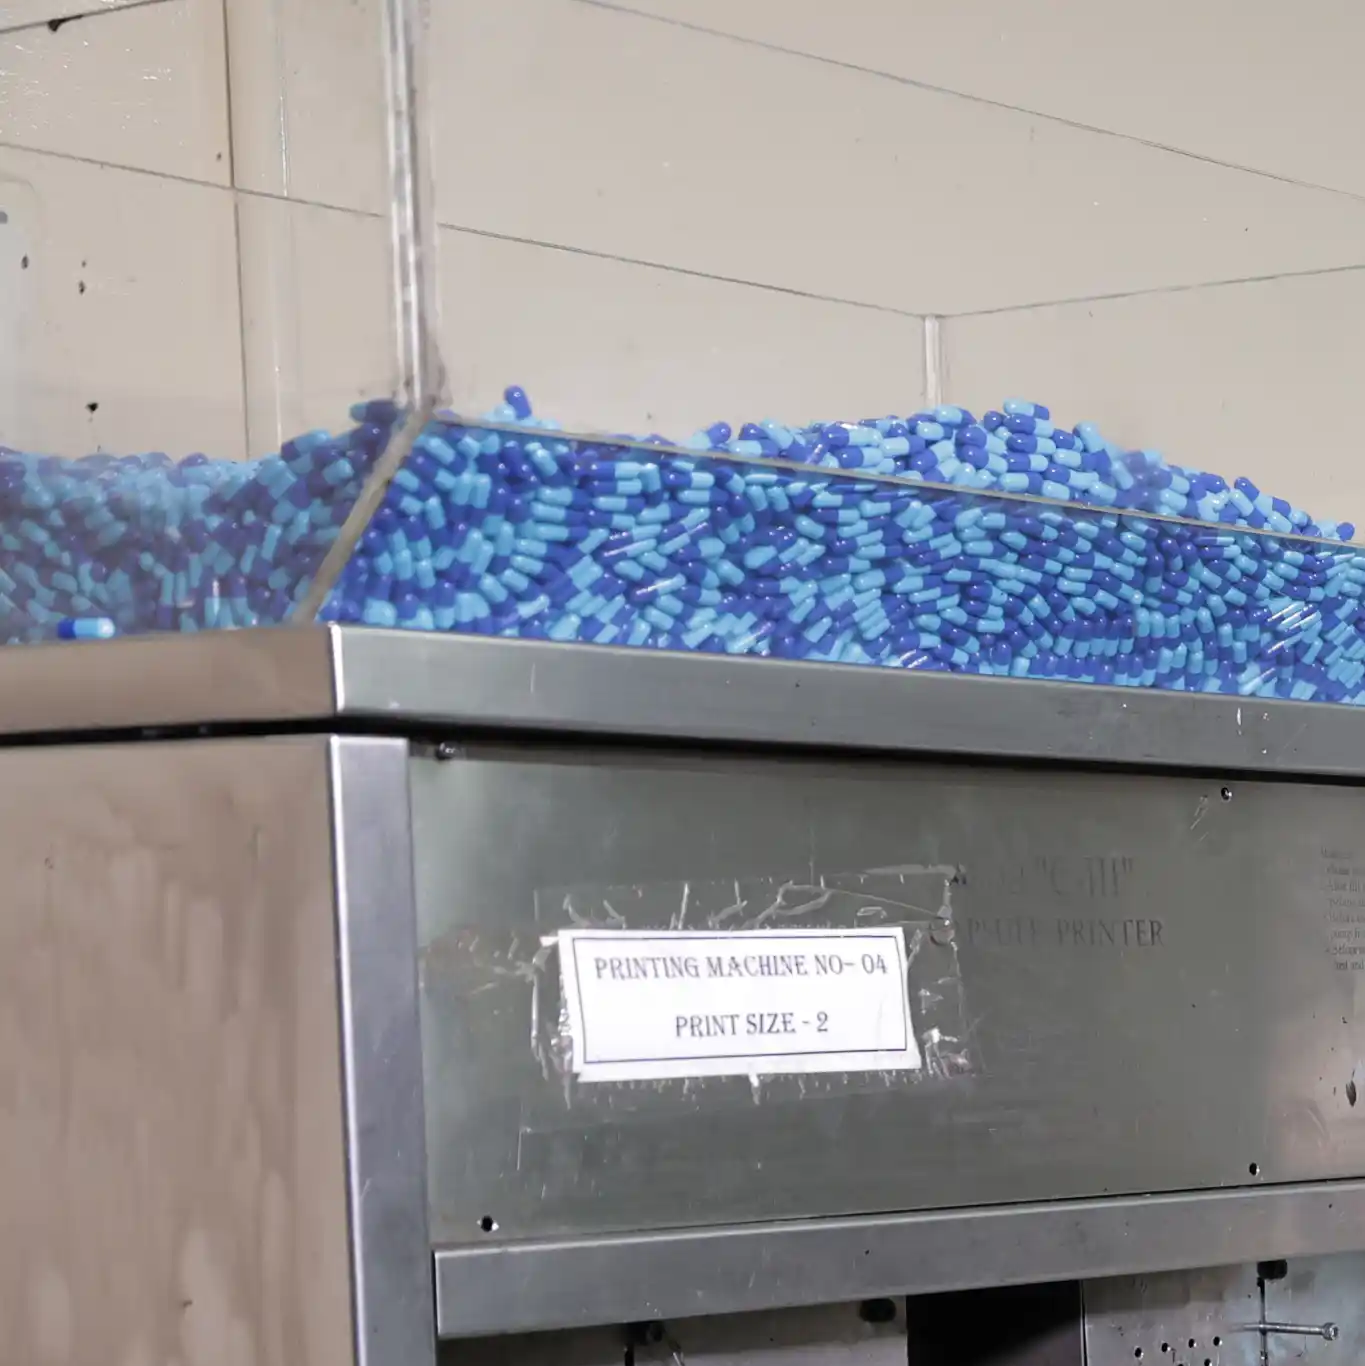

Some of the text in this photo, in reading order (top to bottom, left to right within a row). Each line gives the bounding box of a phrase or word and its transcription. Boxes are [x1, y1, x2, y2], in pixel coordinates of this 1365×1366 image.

[1057, 918, 1164, 947] PRINTER
[594, 956, 701, 980] PRINTING
[705, 953, 808, 978] MACHINE
[861, 953, 888, 975] 04
[676, 1013, 740, 1038] PRINT
[746, 1012, 796, 1035] SIZE
[816, 1011, 829, 1033] 2
